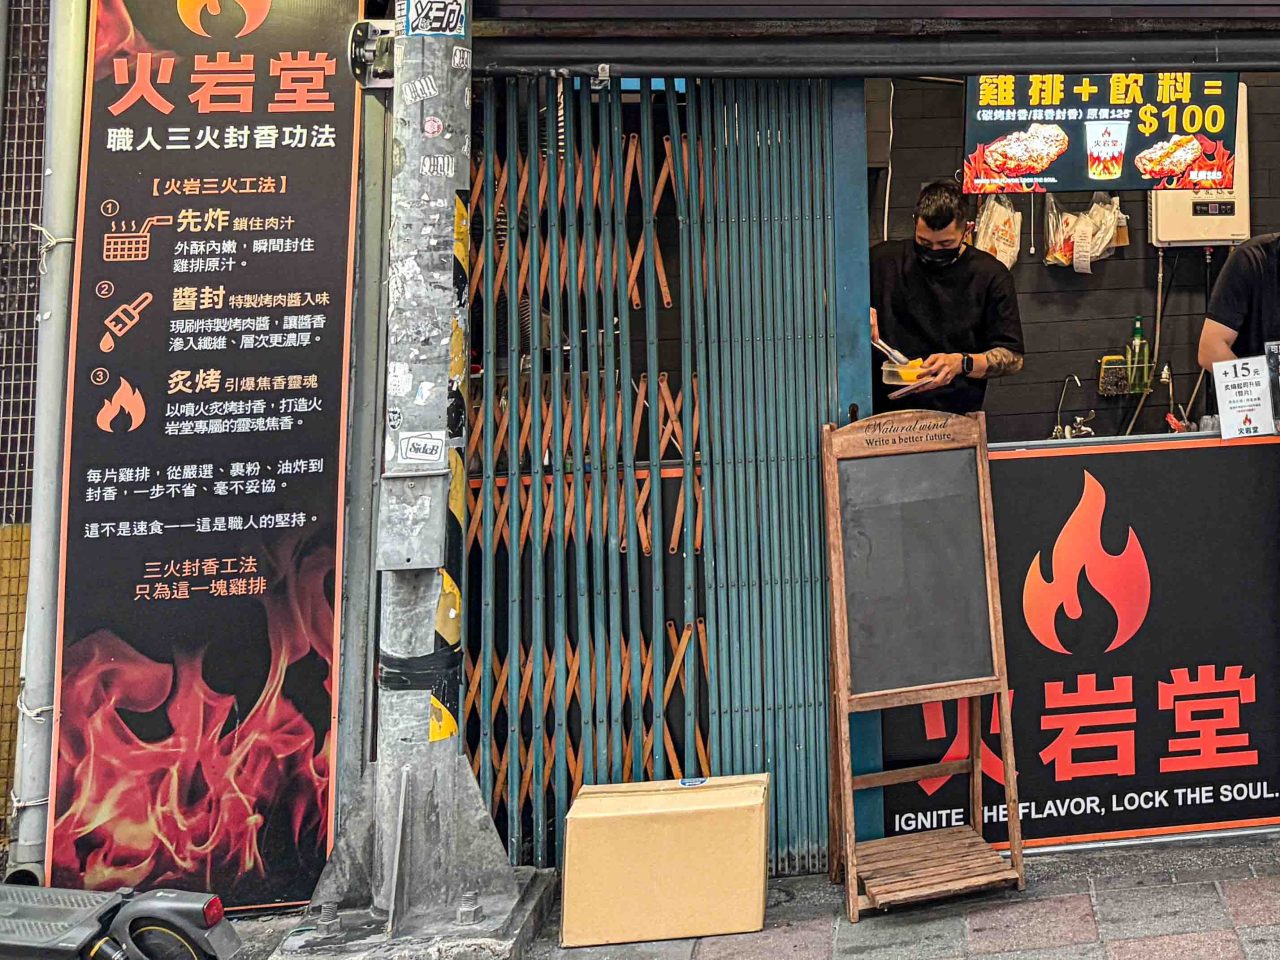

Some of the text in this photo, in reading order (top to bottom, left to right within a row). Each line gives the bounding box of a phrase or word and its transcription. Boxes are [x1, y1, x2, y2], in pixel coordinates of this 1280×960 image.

[107, 51, 337, 117] 火岩堂
[1137, 104, 1225, 137] $100
[106, 124, 337, 152] 職人三火封香功法
[152, 175, 288, 197] 【火岩三火工法】
[177, 208, 295, 233] 先炸 鎖住肉汁
[172, 258, 248, 273] 雞排原汁。
[172, 285, 331, 311] 醬封 特製烤肉醬入味
[167, 368, 319, 395] 炙烤 引爆焦香靈魂
[865, 419, 918, 436] Natural
[866, 438, 889, 447] Write
[898, 435, 923, 444] better
[925, 432, 952, 441] future
[143, 556, 257, 579] 三火封香工法
[133, 577, 267, 601] 只為這一塊雞排
[894, 808, 965, 832] IGNITE
[1019, 794, 1107, 821] FLAVOR,
[1112, 789, 1170, 812] LOCK
[1174, 785, 1215, 806] THE
[1219, 780, 1280, 804] SOUL.
